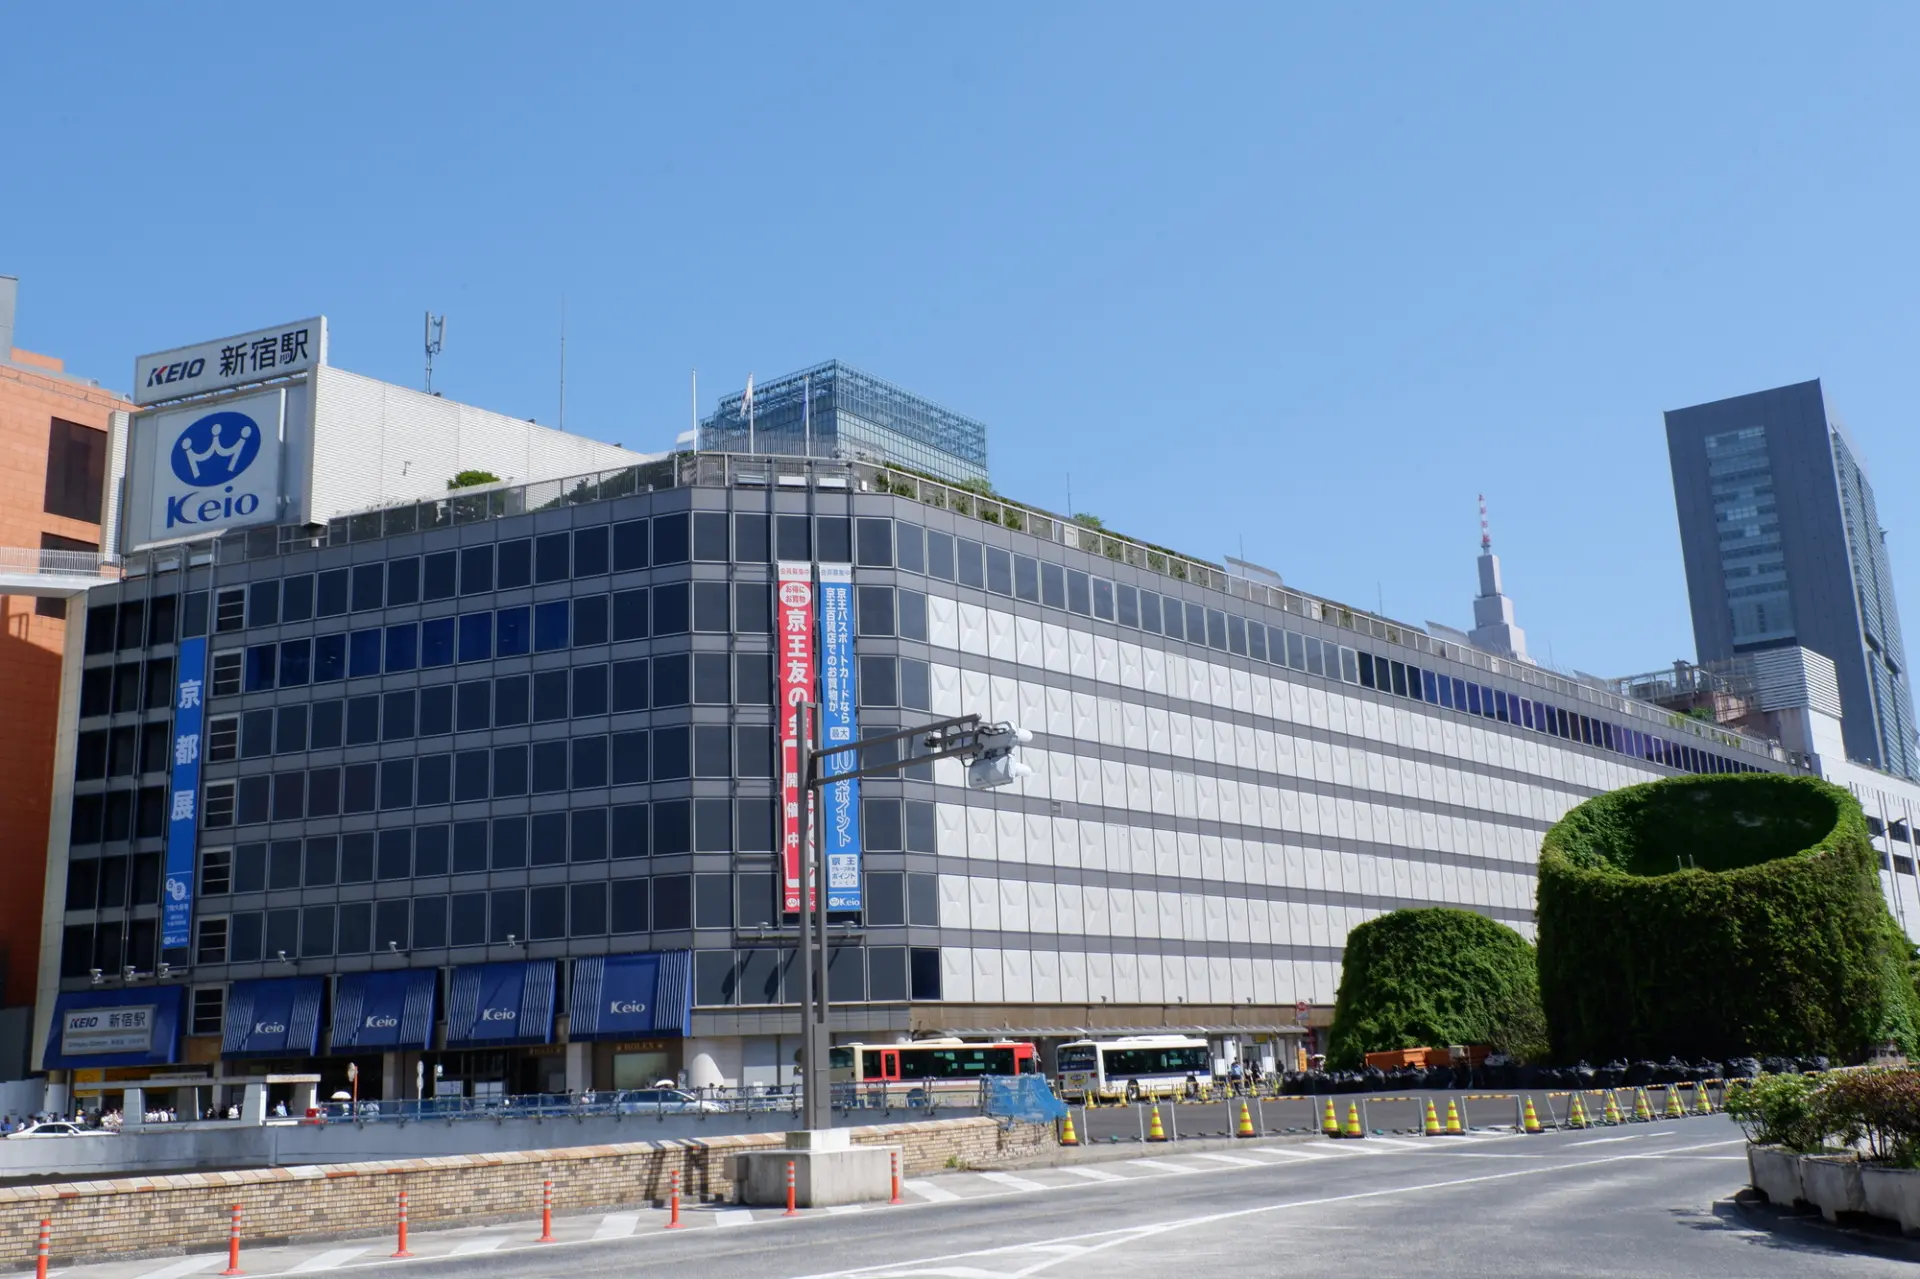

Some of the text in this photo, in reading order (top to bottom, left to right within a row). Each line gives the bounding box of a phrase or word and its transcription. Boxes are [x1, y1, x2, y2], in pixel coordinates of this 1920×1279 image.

[147, 329, 309, 387] KEIO 新宿駅
[167, 486, 259, 529] Keio
[832, 729, 848, 738] 最大
[170, 678, 202, 820] 京都展
[840, 897, 860, 906] Keio
[482, 1007, 516, 1021] Keio
[610, 1000, 646, 1014] Keio
[69, 1011, 146, 1029] KEIO 新宿駅
[365, 1014, 398, 1029] Keio
[254, 1021, 285, 1035] Keio
